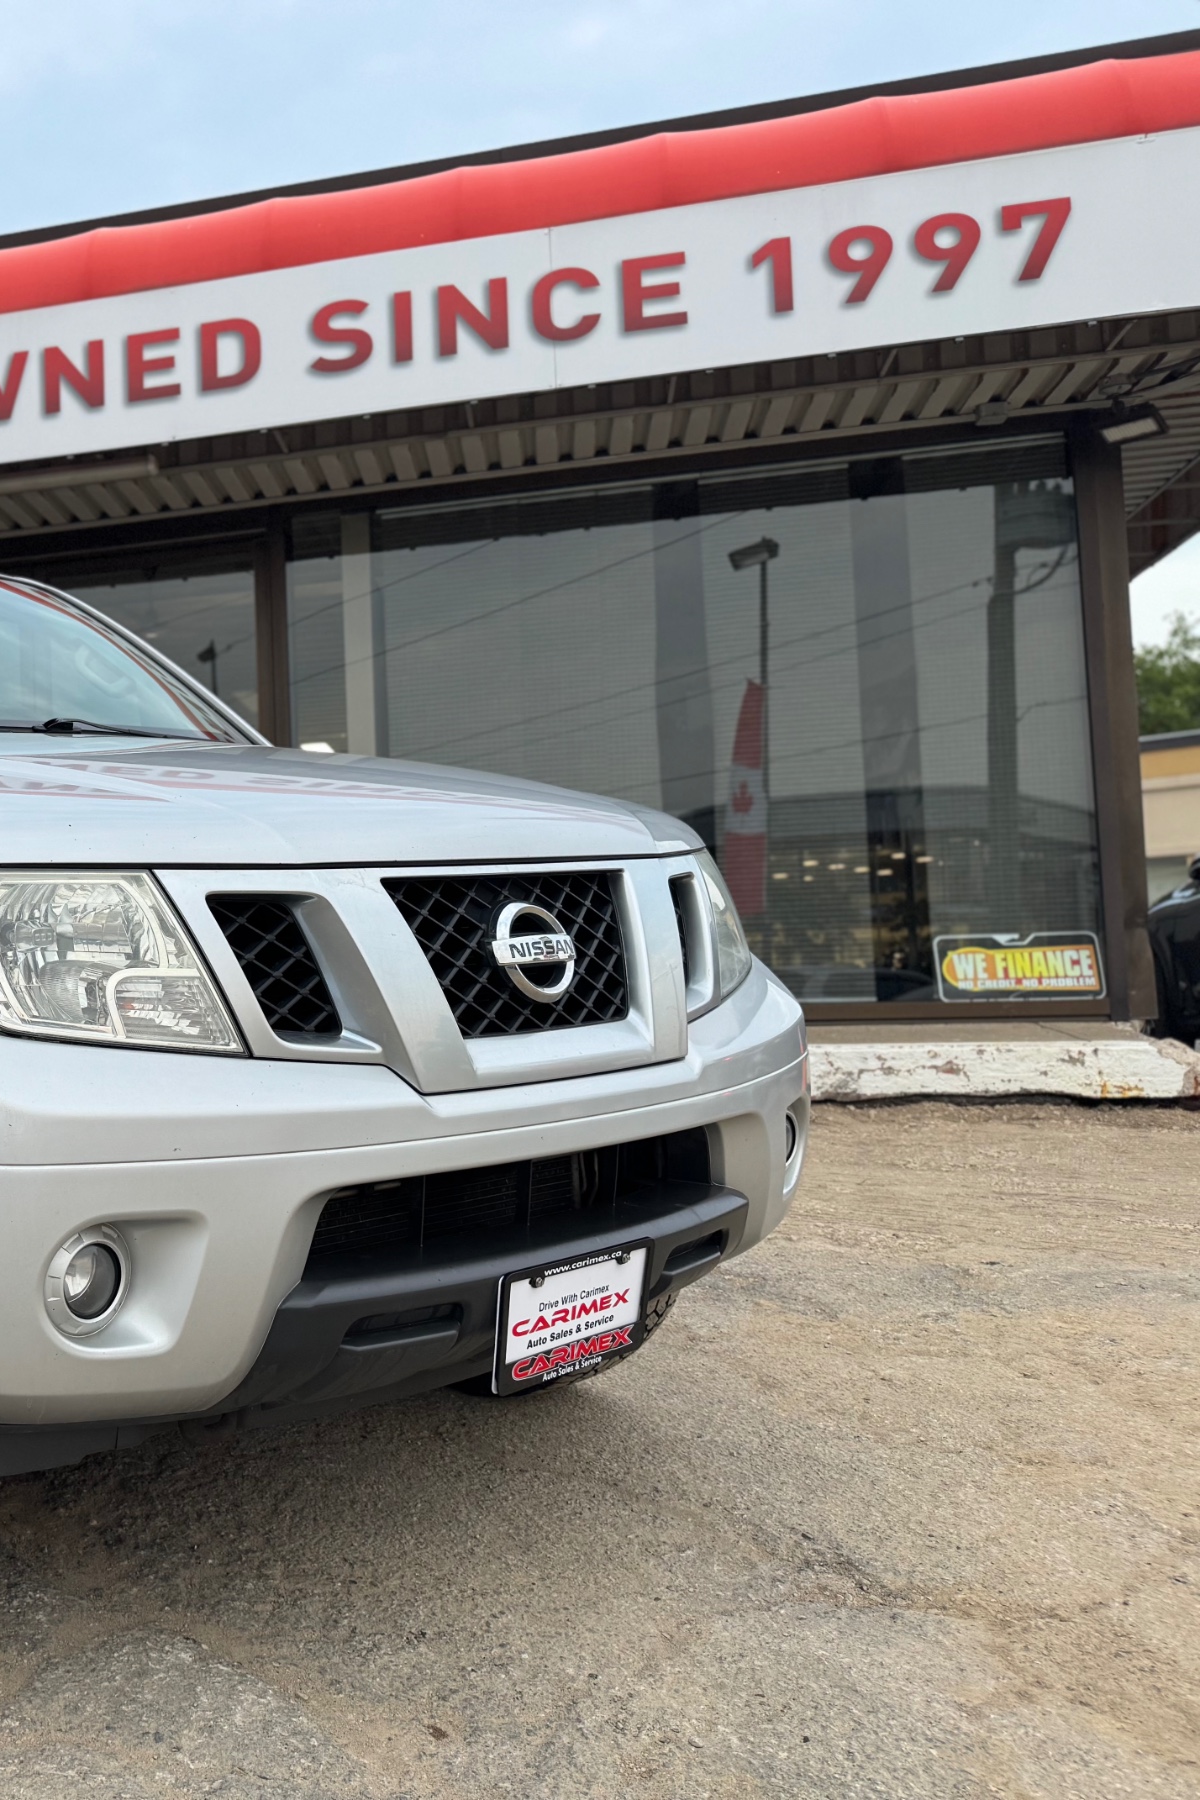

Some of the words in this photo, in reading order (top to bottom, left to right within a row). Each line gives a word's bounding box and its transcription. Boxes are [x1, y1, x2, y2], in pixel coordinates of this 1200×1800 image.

[308, 251, 689, 374] SINCE
[750, 196, 1072, 314] 1997
[508, 938, 575, 960] NISSAN
[952, 952, 989, 980] WE
[994, 949, 1094, 979] FINANCE
[958, 980, 974, 990] NO
[1022, 978, 1039, 987] NO
[1043, 976, 1096, 987] PROBLEM
[543, 1251, 622, 1277] www.carimex.ca
[511, 1288, 630, 1338] CARIMEX
[539, 1300, 559, 1313] Drive
[561, 1293, 578, 1305] With
[580, 1284, 610, 1300] Carimex
[527, 1337, 548, 1350] Auto
[550, 1329, 573, 1342] Sales
[575, 1323, 582, 1333] &
[584, 1314, 615, 1330] Service
[512, 1324, 634, 1381] CARIMEX
[542, 1371, 557, 1382] Auto
[558, 1365, 574, 1377] Sales
[575, 1361, 580, 1370] &
[581, 1355, 602, 1369] Service
